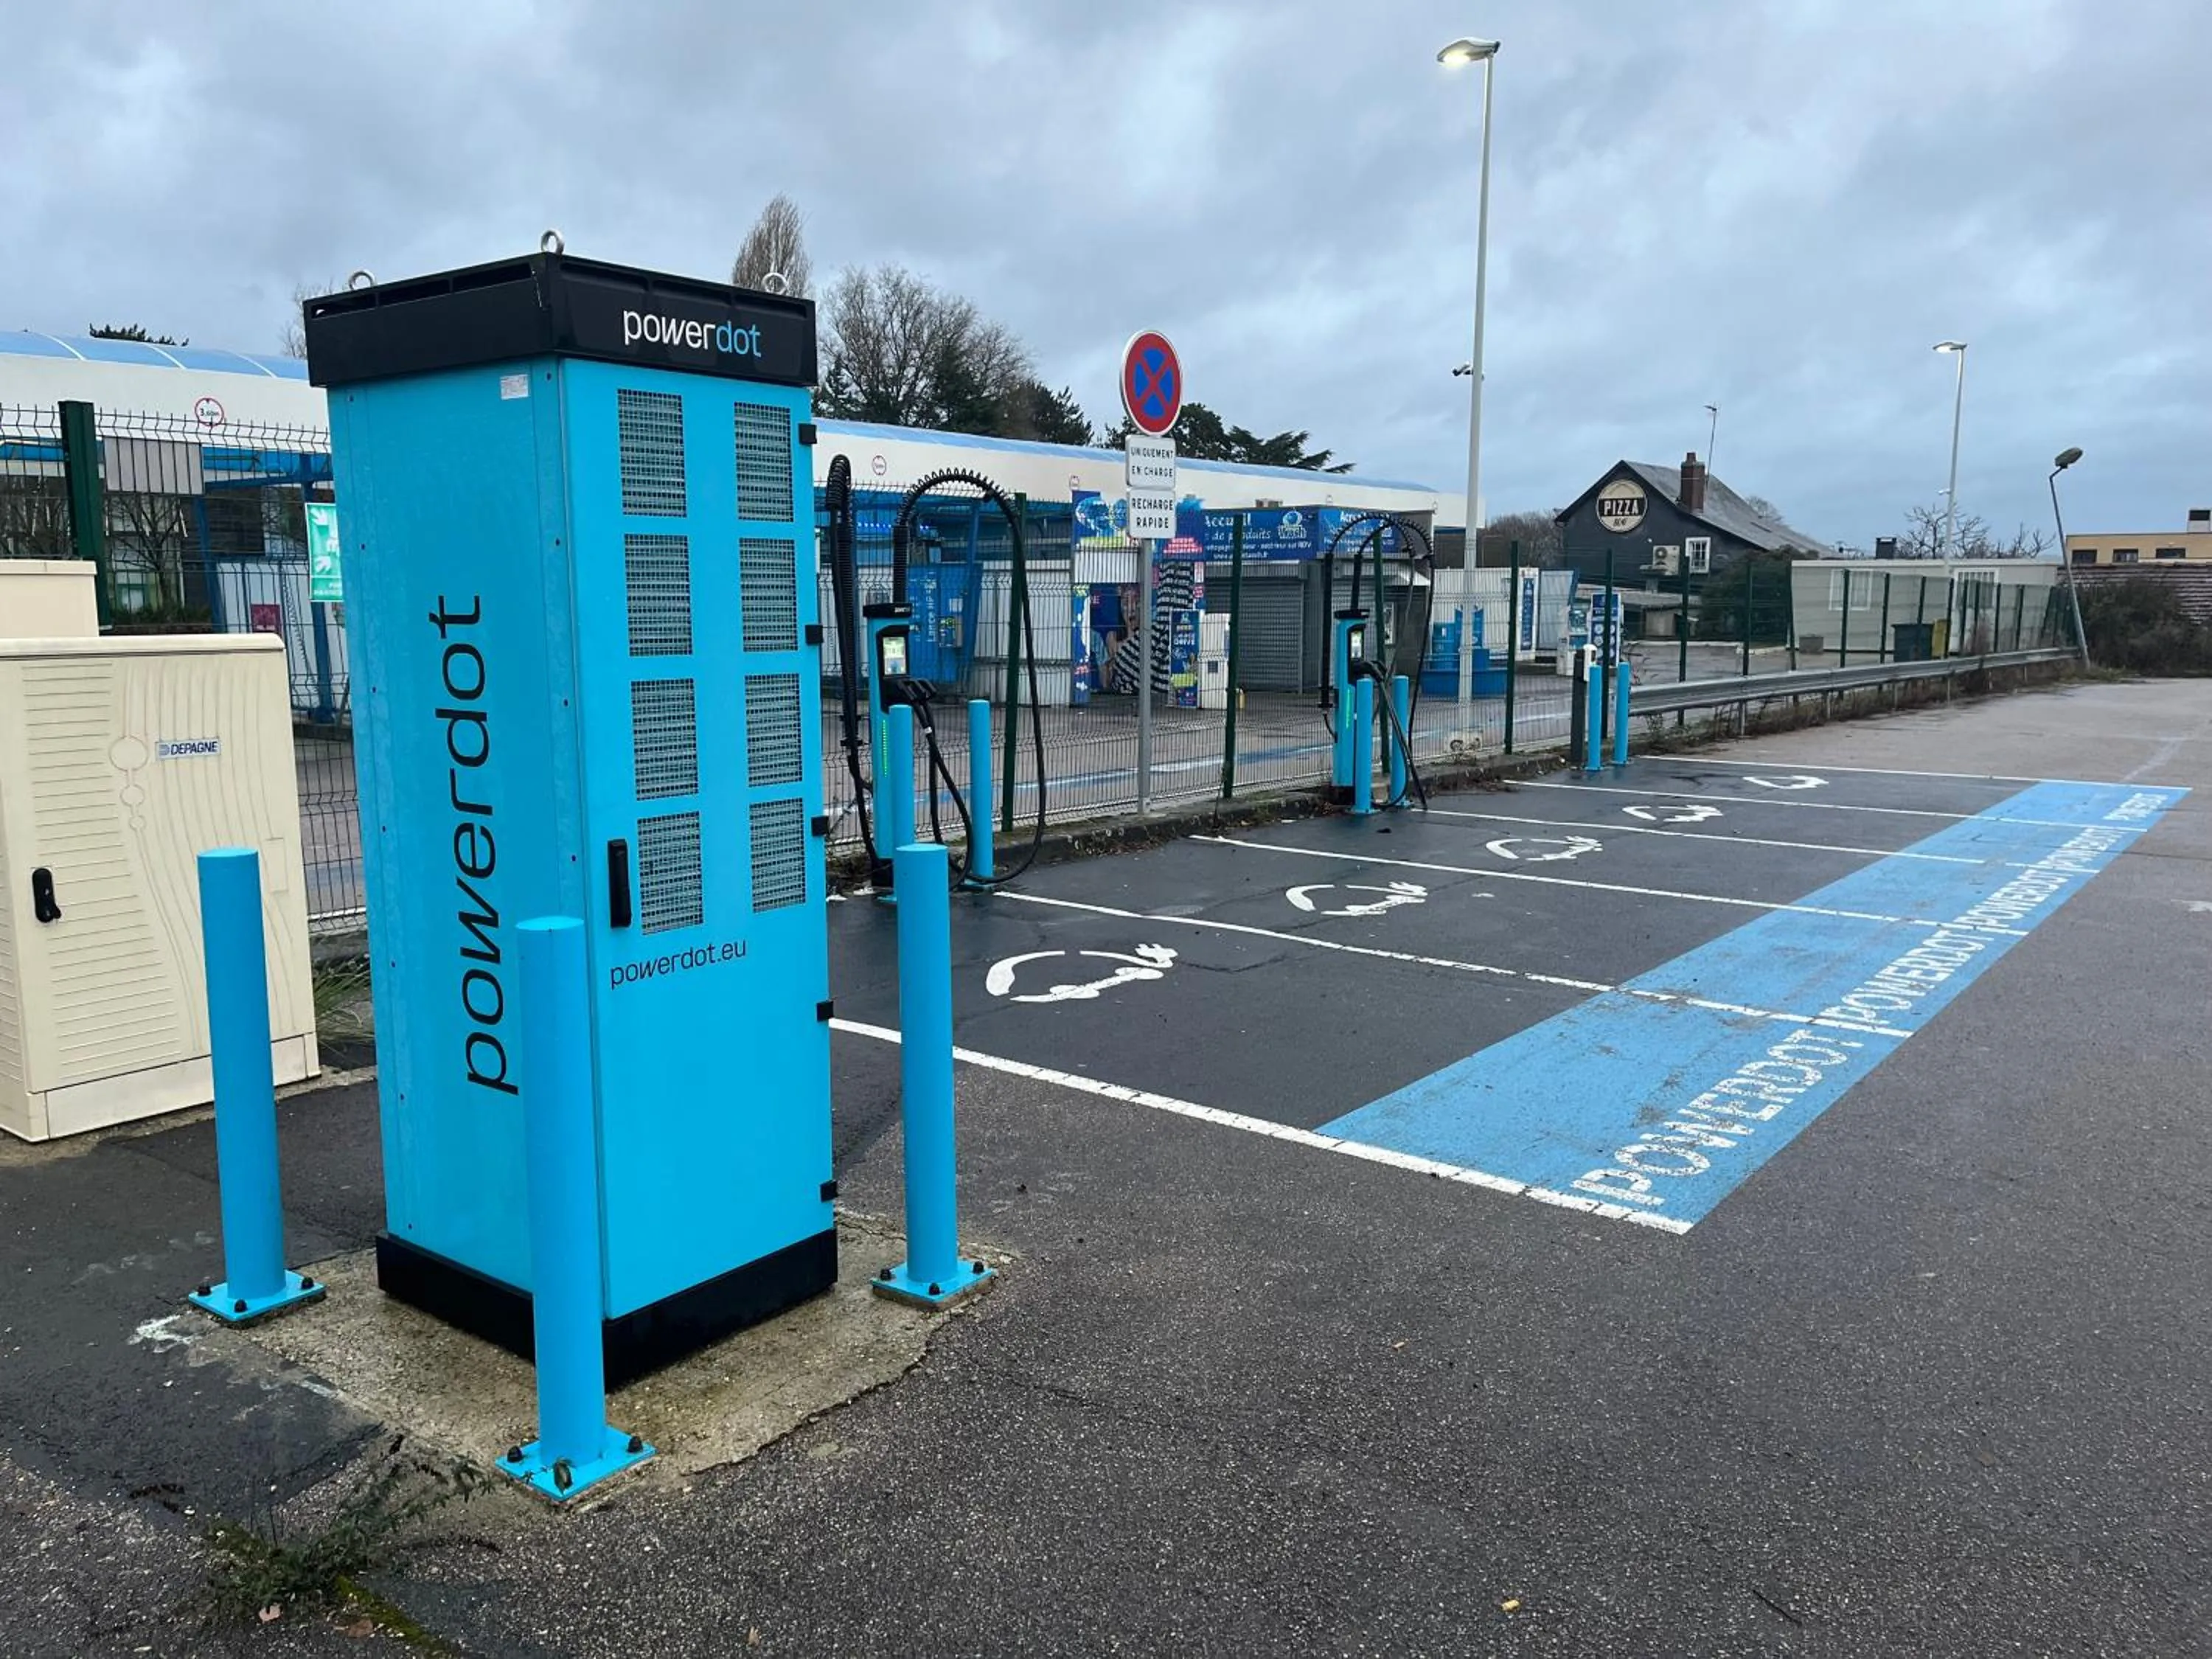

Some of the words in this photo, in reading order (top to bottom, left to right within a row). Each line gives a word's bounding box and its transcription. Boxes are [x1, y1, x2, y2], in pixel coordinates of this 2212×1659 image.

[623, 310, 762, 358] powerdot
[1132, 465, 1141, 475] EN
[1144, 466, 1173, 477] CHARGE
[1132, 498, 1173, 510] RECHARGE
[1136, 517, 1169, 529] RAPIDE
[1604, 499, 1638, 515] PIZZA
[170, 741, 218, 755] DEPAGNE
[428, 595, 519, 1095] powerdot
[1953, 869, 2074, 929] POWERDOT
[611, 940, 746, 990] powerdot.eu
[1819, 929, 1994, 1024] POWERDOT
[1571, 1029, 1865, 1206] POWERDOT
